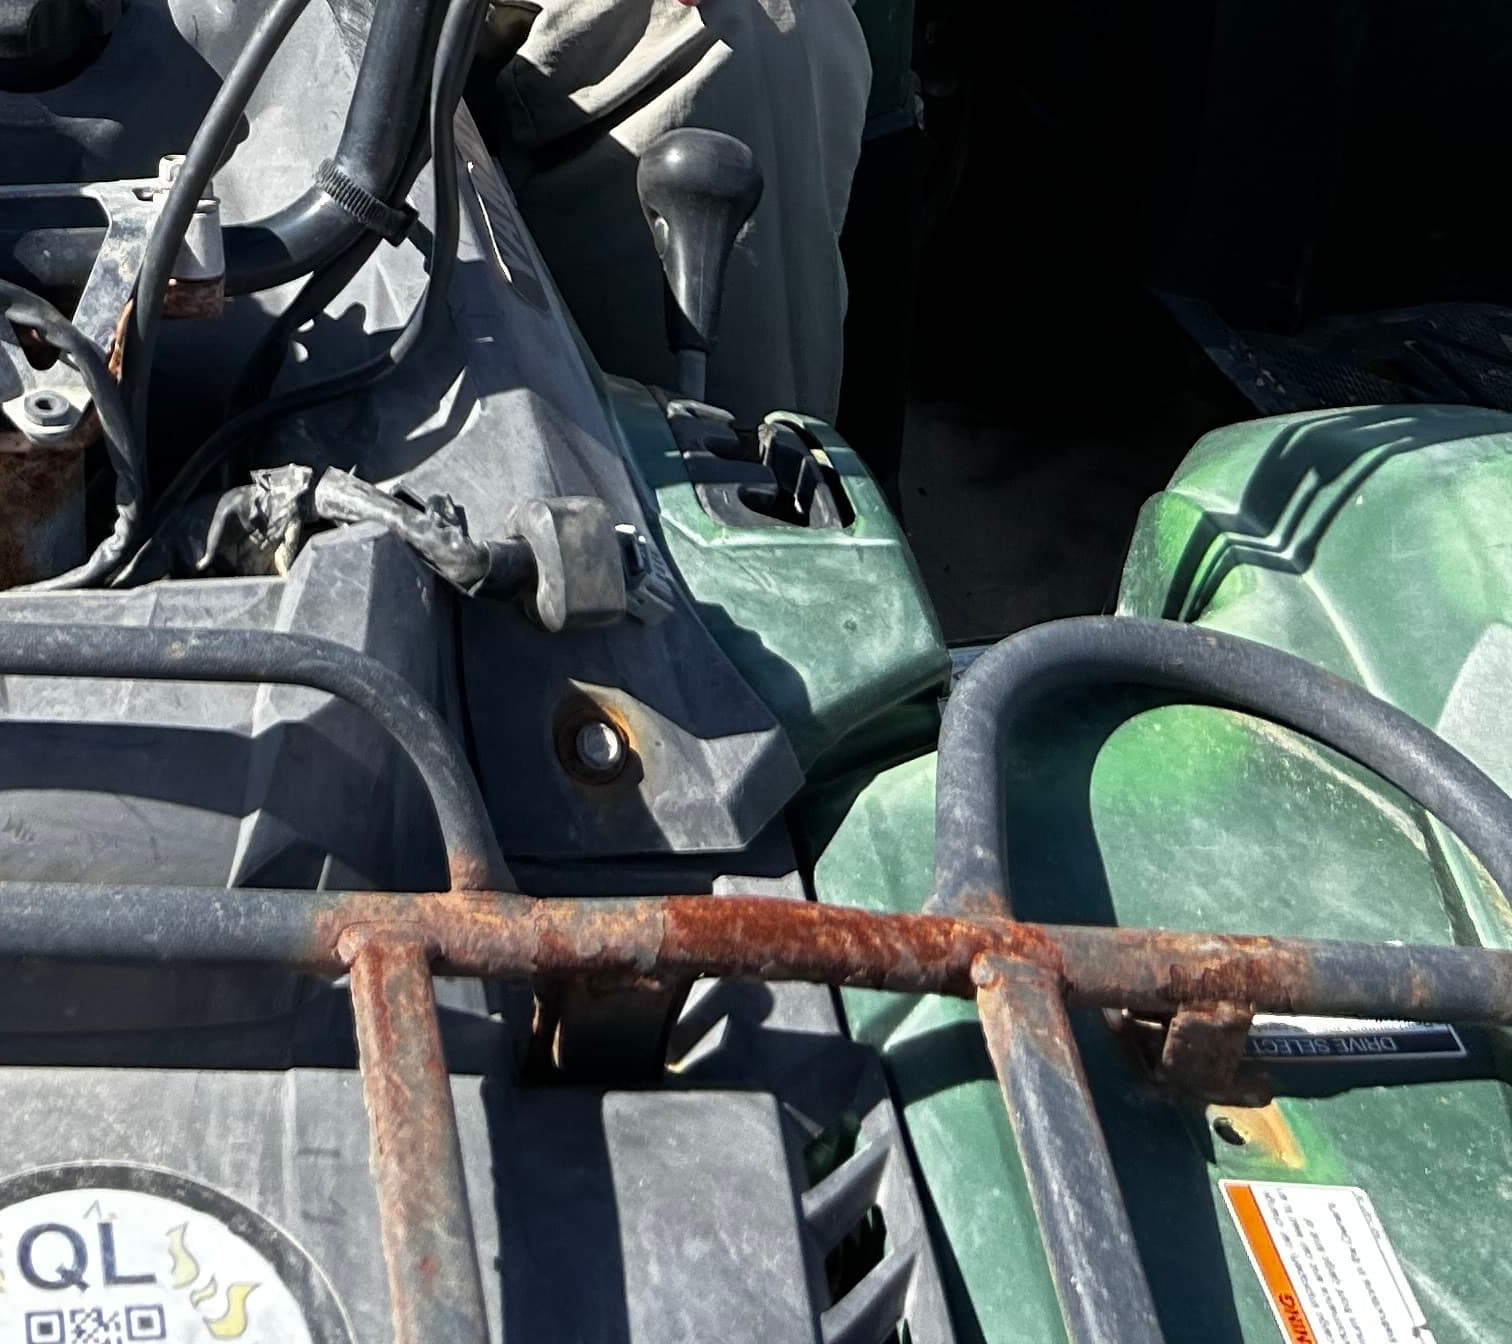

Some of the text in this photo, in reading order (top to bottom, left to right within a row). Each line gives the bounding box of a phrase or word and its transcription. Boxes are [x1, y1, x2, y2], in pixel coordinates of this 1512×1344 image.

[1251, 1036, 1398, 1055] DRIVE SELECT
[16, 1219, 156, 1292] QL
